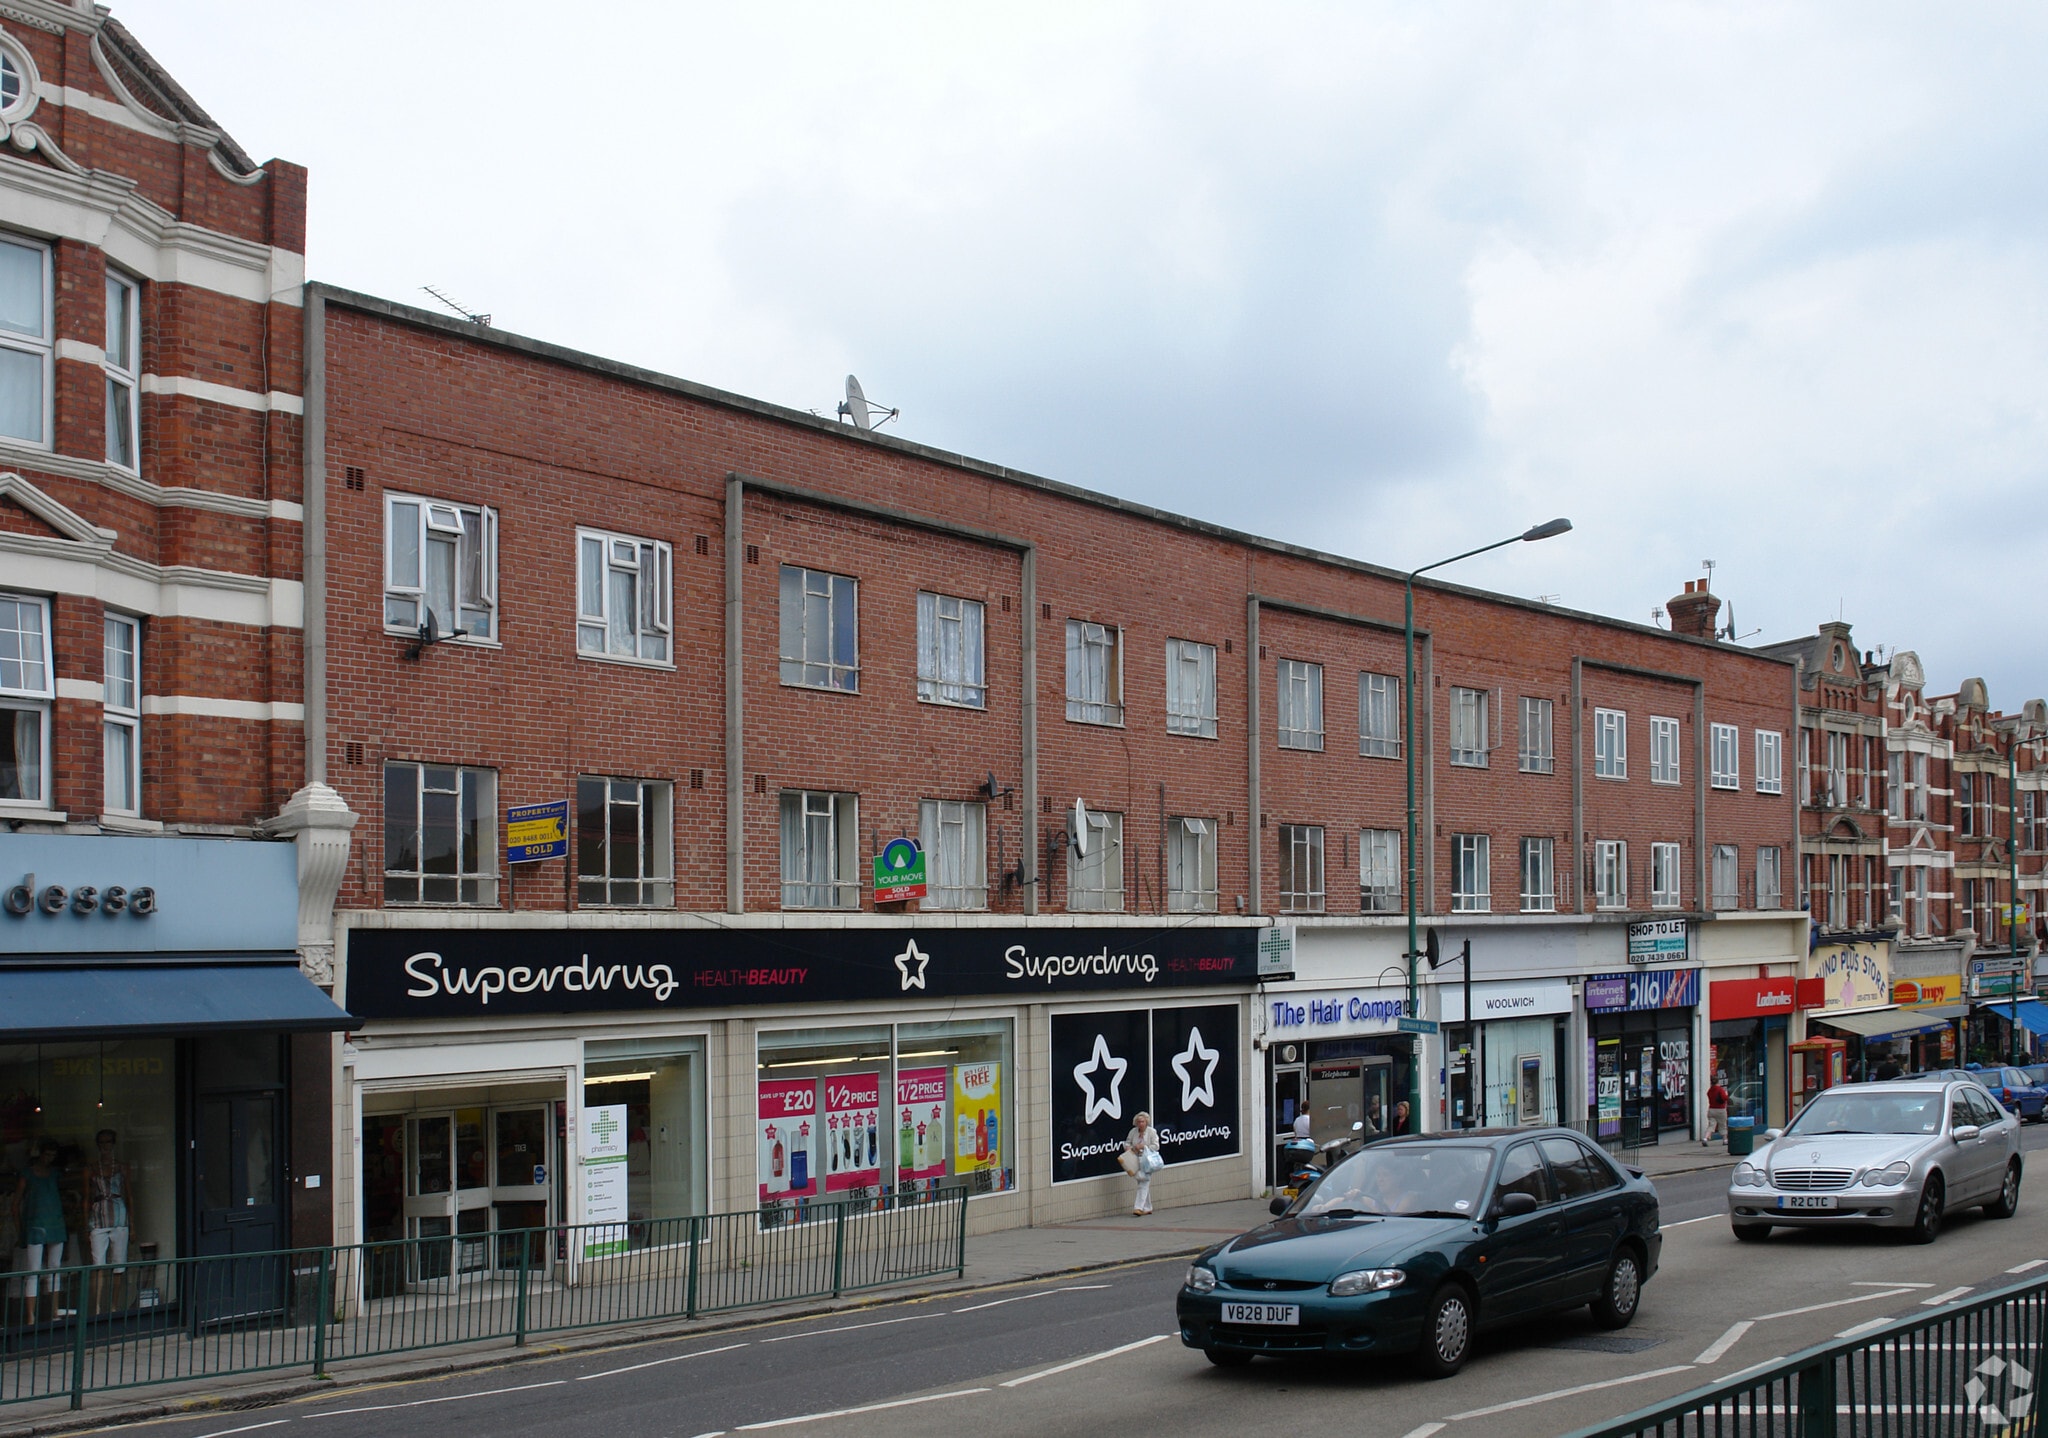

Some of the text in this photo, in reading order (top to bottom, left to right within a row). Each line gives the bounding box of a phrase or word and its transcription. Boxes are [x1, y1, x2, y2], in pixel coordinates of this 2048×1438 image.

[511, 807, 551, 817] PROPERTY
[510, 836, 521, 844] 020
[540, 832, 553, 841] 0011
[525, 844, 554, 855] SOLD
[878, 872, 923, 884] YOUR MOVE
[3, 872, 159, 915] dessa
[1630, 921, 1686, 936] SHOP TO LET
[1004, 944, 1160, 984] Superdrug
[1630, 951, 1685, 963] 020 7439 0661
[404, 952, 679, 1004] Superdrug
[1815, 950, 1886, 998] UND PLUS STORE
[1586, 984, 1624, 996] internet
[1630, 973, 1660, 1007] ollo
[1756, 990, 1792, 1007] Ladbrokes
[1921, 983, 1946, 1003] impy
[1485, 996, 1535, 1010] WOOLWICH
[1604, 994, 1624, 1005] café
[1272, 1001, 1306, 1027] The
[1311, 998, 1345, 1025] Hair
[1660, 1041, 1689, 1060] CLOSING
[1321, 1069, 1350, 1079] Telephone
[1665, 1060, 1689, 1077] DOWN
[963, 1071, 990, 1089] FREE
[1664, 1075, 1686, 1100] SALE
[783, 1089, 814, 1111] £20
[827, 1085, 878, 1108] 1/2 PRICE
[898, 1081, 943, 1102] 1/2 PRICE
[1160, 1124, 1232, 1145] Superdrug
[591, 1144, 618, 1153] pharmacy
[1060, 1137, 1126, 1161] Superdr
[849, 1186, 869, 1200] FREE
[1790, 1196, 1828, 1207] R2 CTC
[1227, 1305, 1294, 1322] V828 DUF
